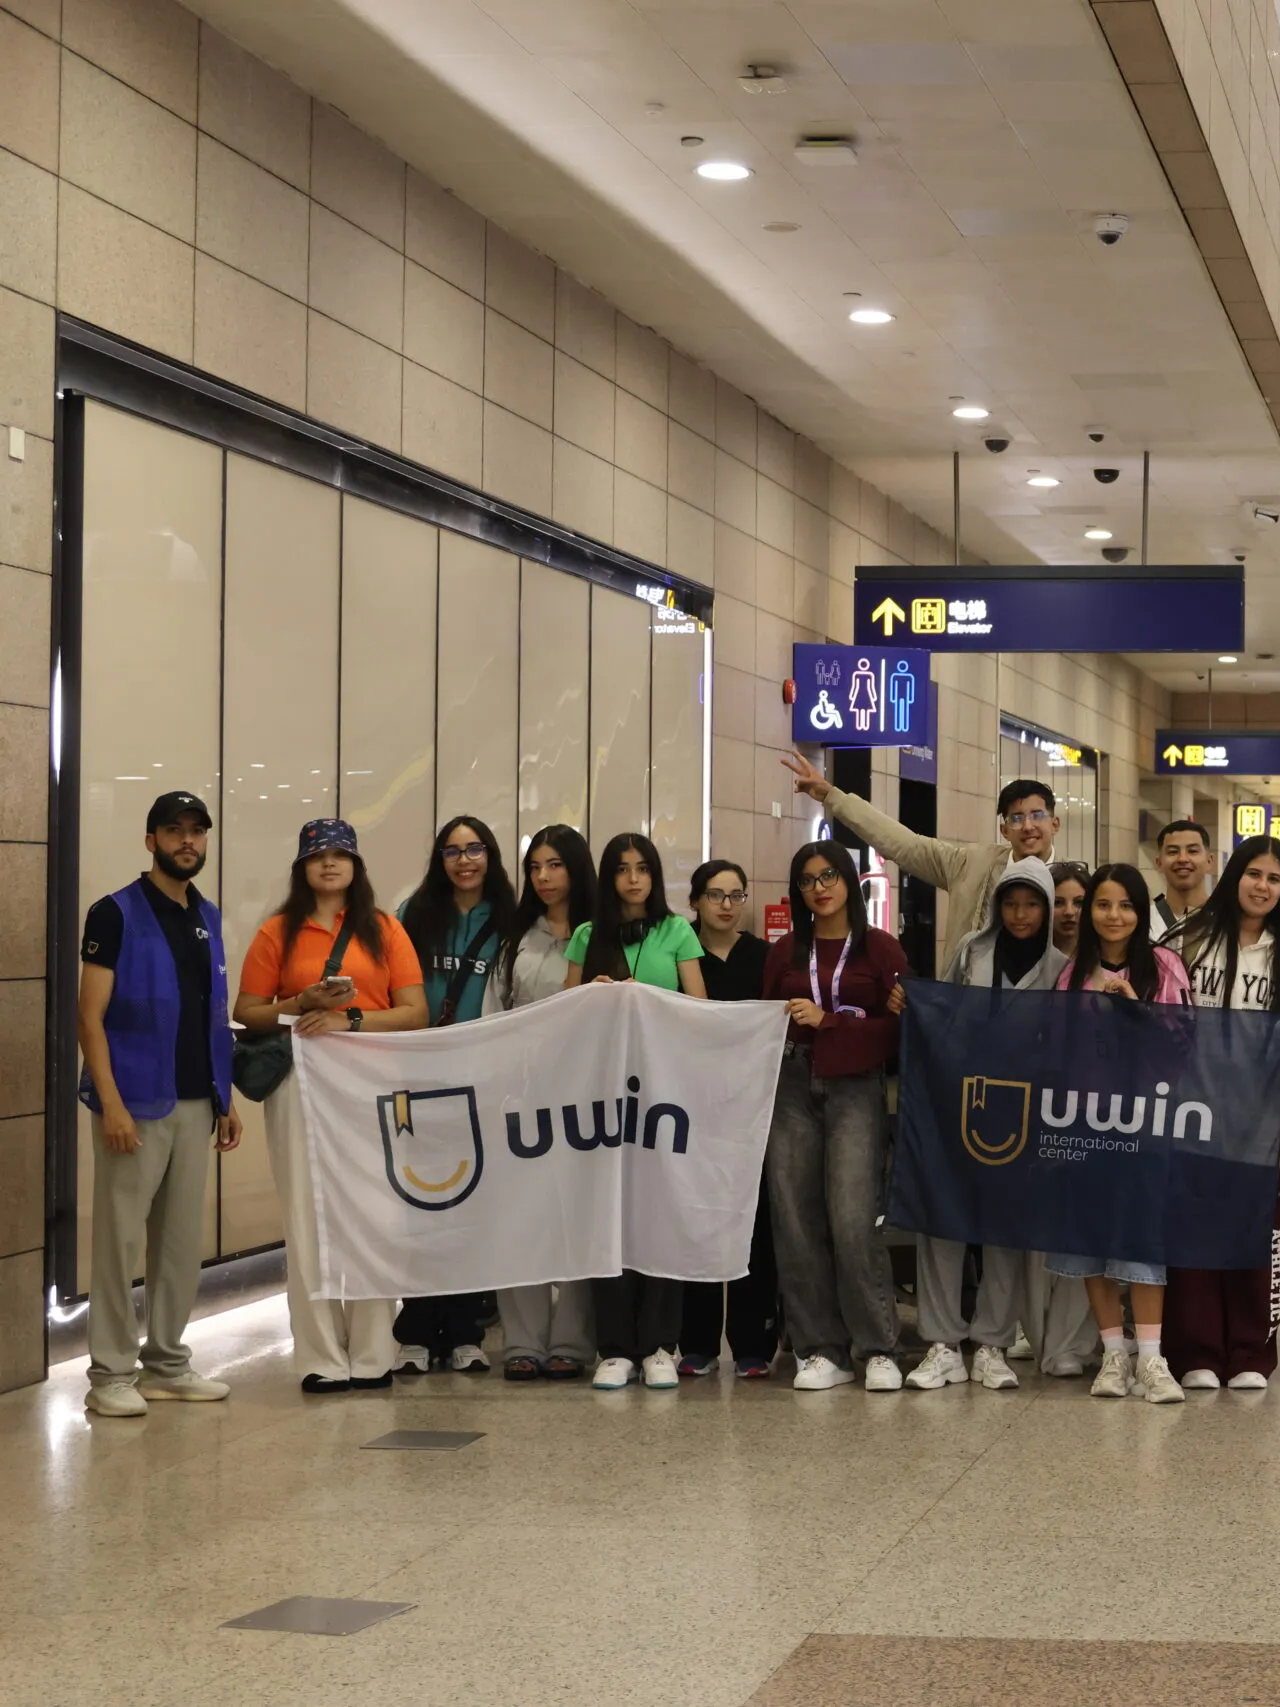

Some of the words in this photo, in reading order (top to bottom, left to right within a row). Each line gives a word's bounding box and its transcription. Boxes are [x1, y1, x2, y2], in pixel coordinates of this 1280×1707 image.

[948, 622, 992, 633] Elevator
[1190, 964, 1224, 996] EW
[505, 1075, 690, 1159] uwin
[1040, 1081, 1213, 1141] uwin
[1038, 1146, 1089, 1161] center
[1039, 1131, 1139, 1153] international
